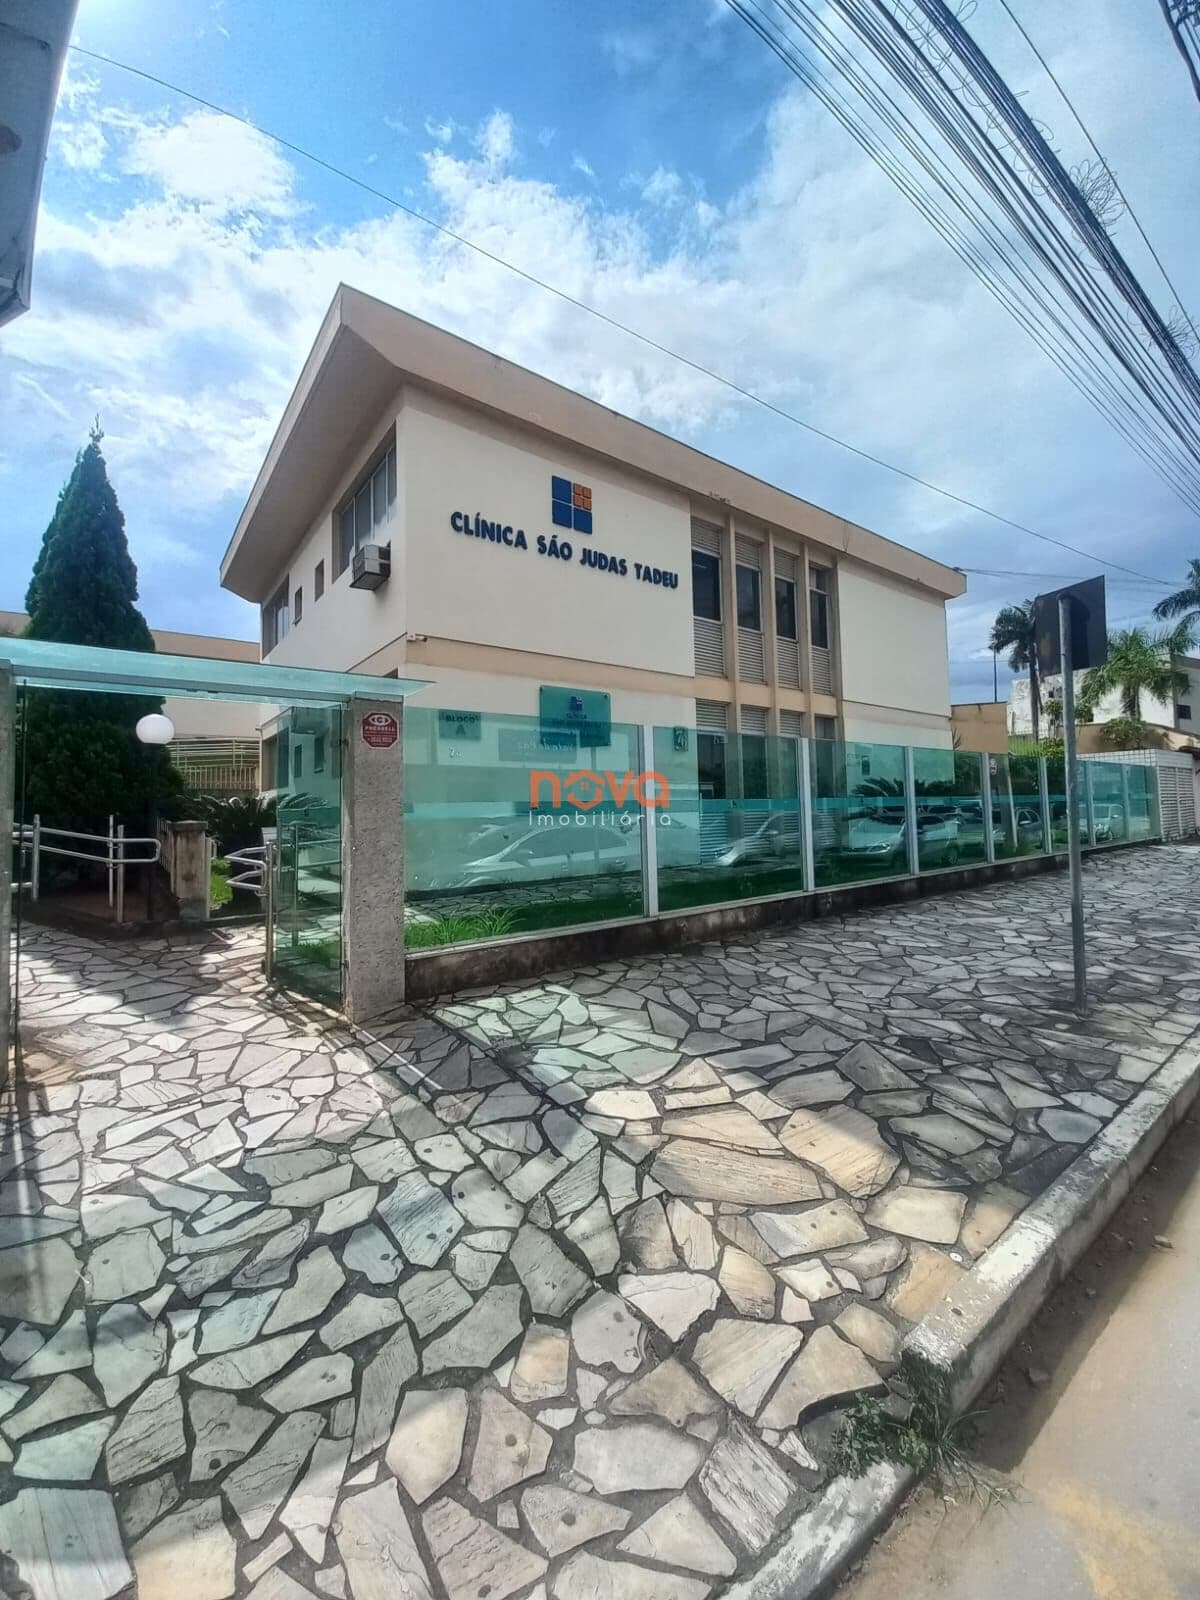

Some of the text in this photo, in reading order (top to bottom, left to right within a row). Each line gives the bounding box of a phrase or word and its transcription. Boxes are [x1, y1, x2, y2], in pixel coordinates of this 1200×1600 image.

[450, 511, 678, 589] CLÍNICA SÃO JUDAS TADEU
[445, 714, 475, 724] BLOCO
